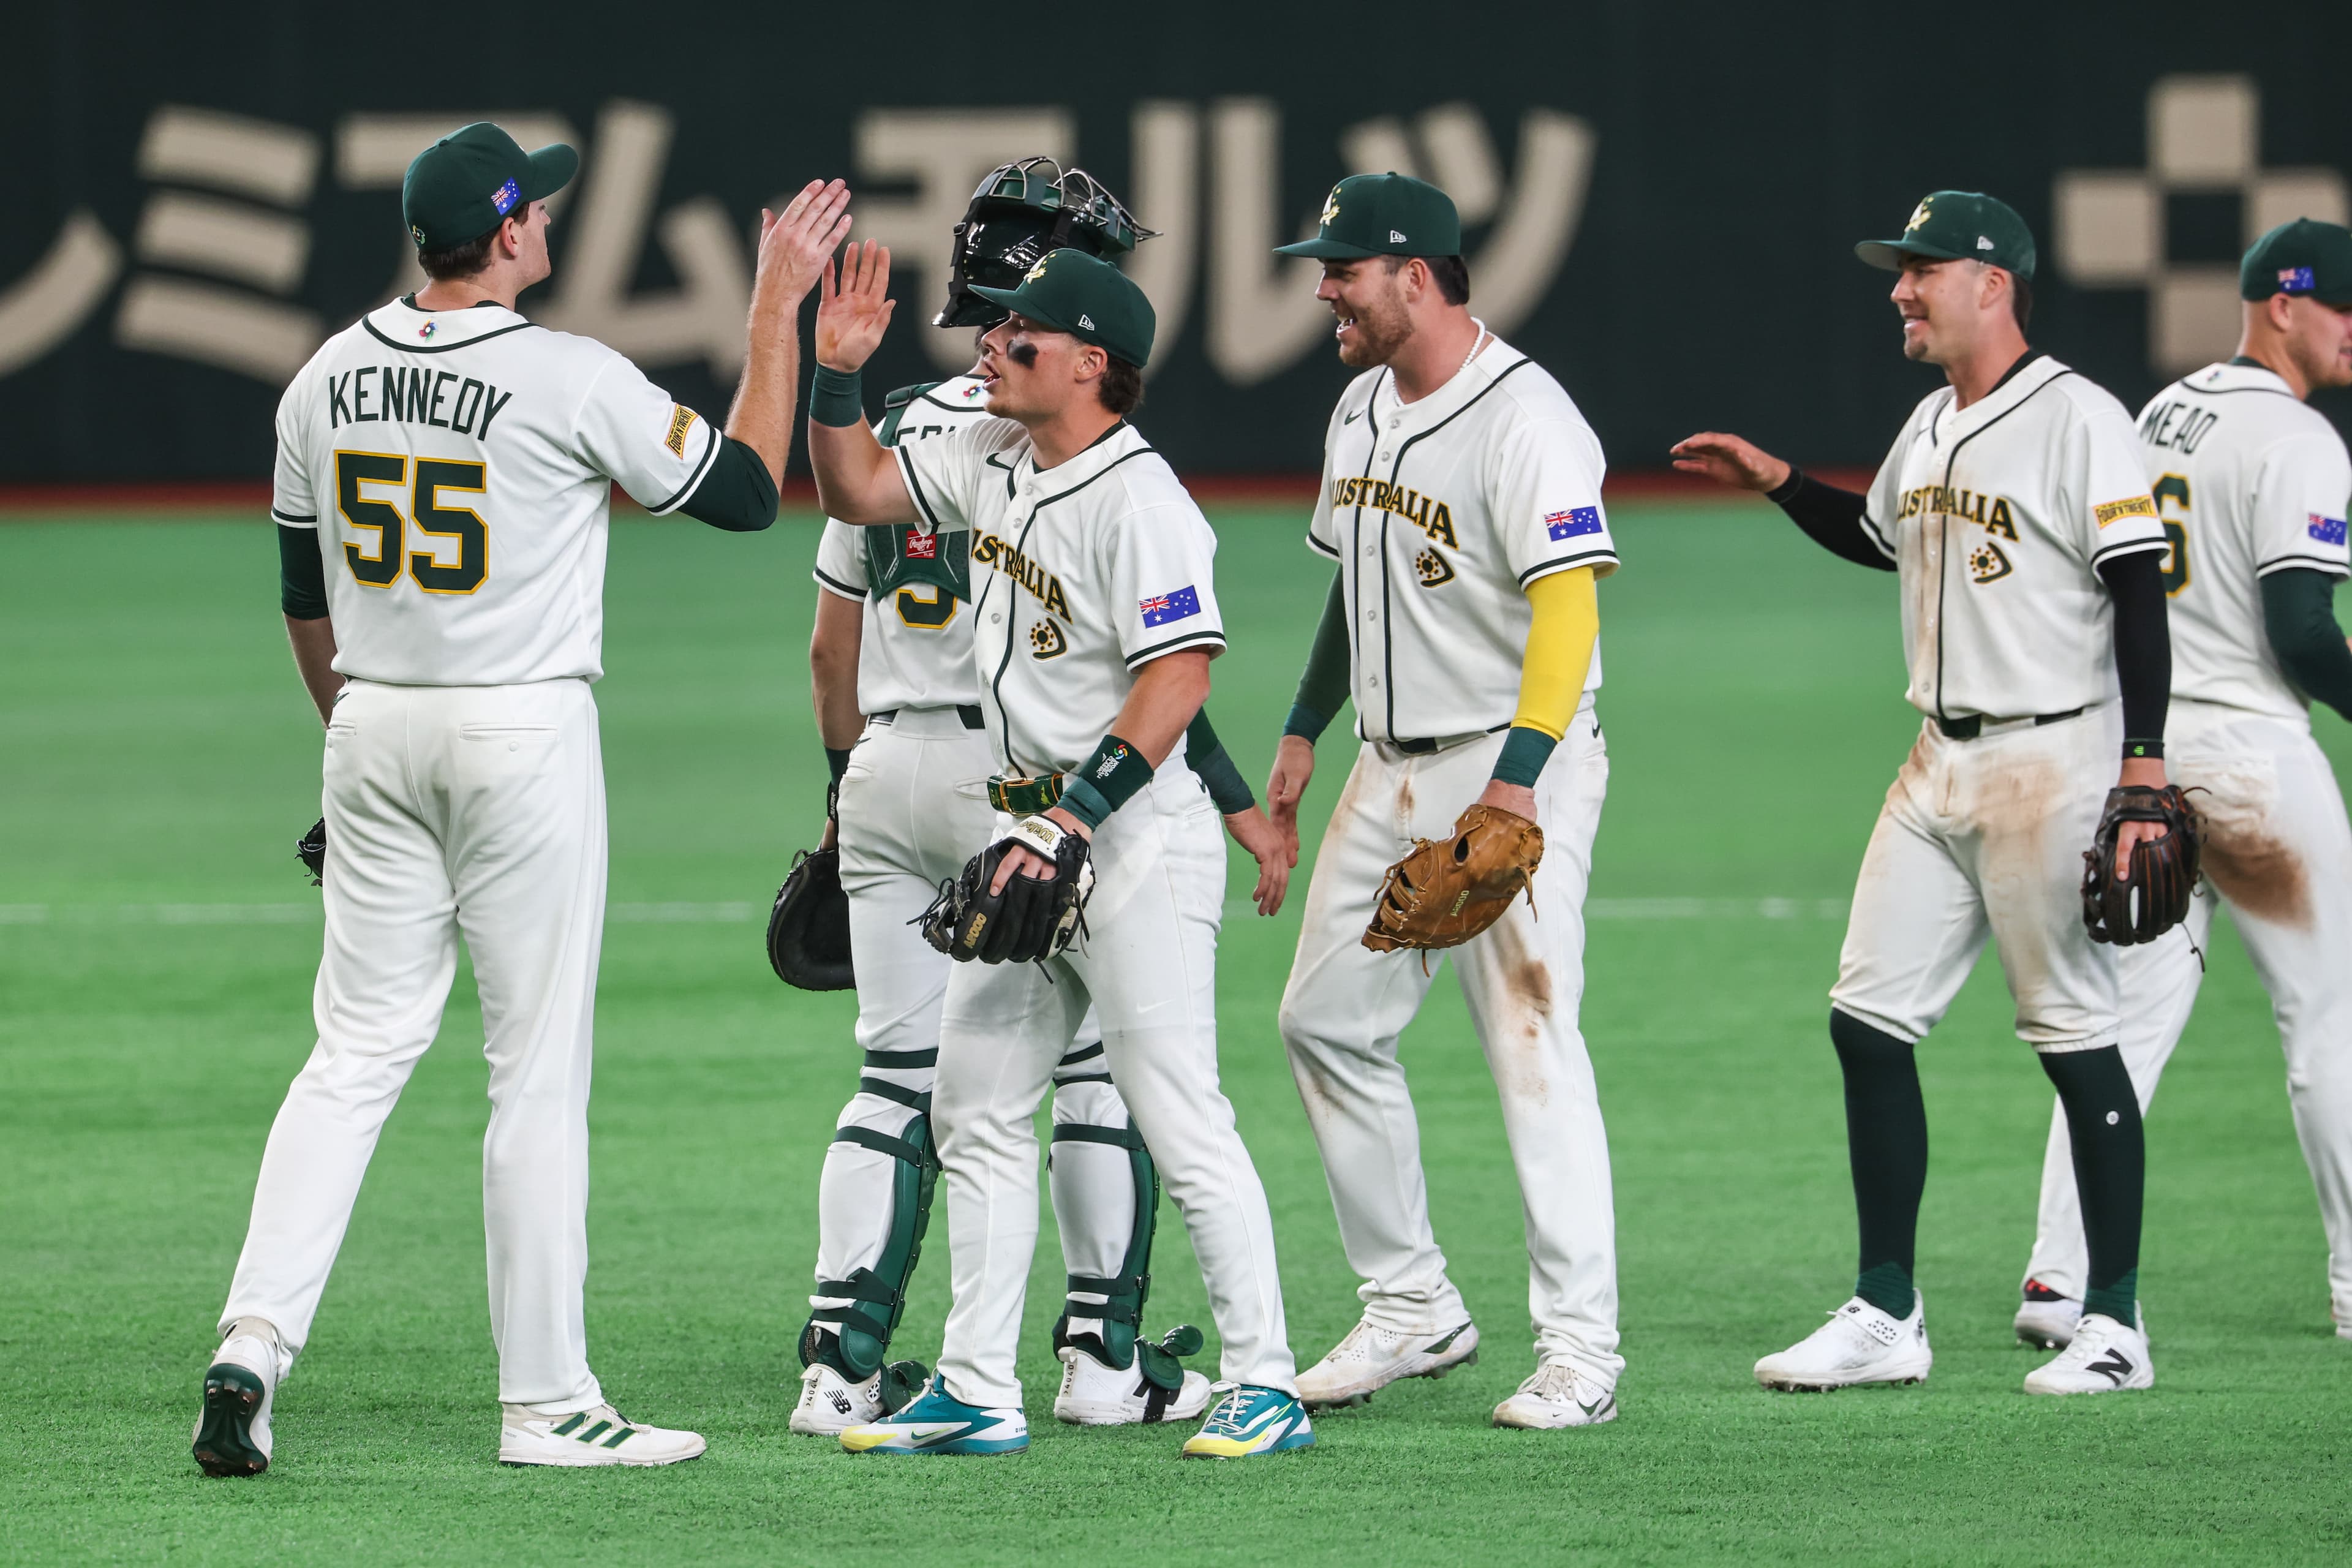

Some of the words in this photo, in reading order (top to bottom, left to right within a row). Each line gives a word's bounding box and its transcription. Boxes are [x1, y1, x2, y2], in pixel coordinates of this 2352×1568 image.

[329, 366, 513, 441] KENNEDY
[2140, 400, 2219, 455] MEAD
[334, 449, 489, 595] 55
